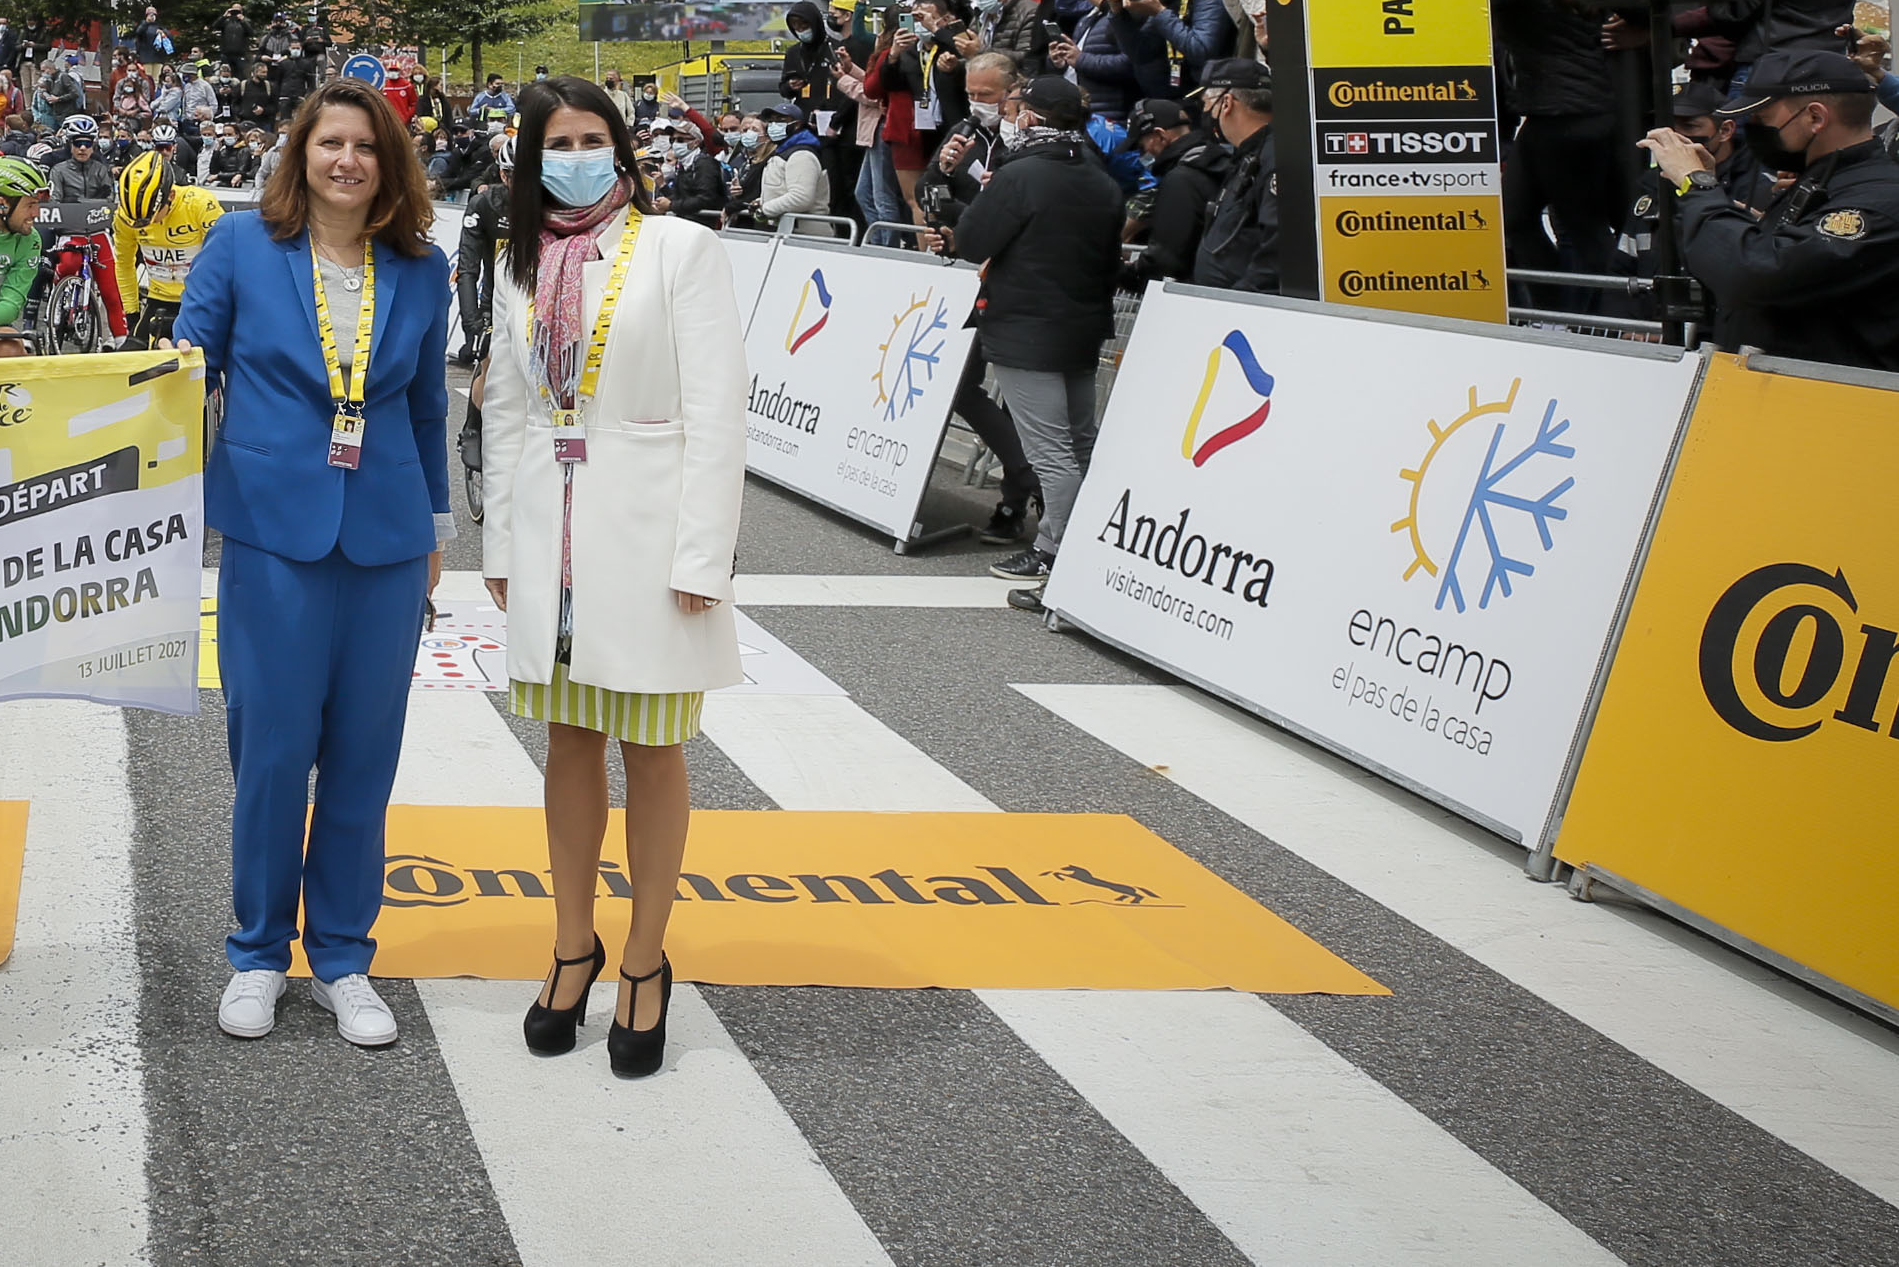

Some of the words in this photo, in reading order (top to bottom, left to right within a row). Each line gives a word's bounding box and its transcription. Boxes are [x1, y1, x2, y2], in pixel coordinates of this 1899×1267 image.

[1328, 80, 1457, 108] Continental
[1790, 82, 1832, 94] POLICIA
[1369, 132, 1488, 154] TISSOT
[168, 224, 198, 237] LCL
[202, 219, 217, 229] LC
[1335, 210, 1466, 237] Continental
[152, 249, 186, 262] UAE
[1338, 269, 1469, 297] Continental
[747, 372, 821, 436] Andorra
[847, 425, 909, 478] encamp
[843, 467, 860, 487] pas
[878, 477, 898, 498] casa
[2, 547, 44, 590] DE
[53, 534, 96, 573] LA
[104, 512, 188, 563] CASA
[1096, 489, 1277, 610] Andorra
[1103, 566, 1234, 642] visitandorra.com
[77, 660, 93, 680] 13
[96, 646, 155, 676] JUILLET
[157, 640, 188, 661] 2021
[1347, 607, 1513, 716] encamp
[1331, 661, 1353, 695] el
[1349, 672, 1386, 714] pas
[1388, 680, 1416, 719] de
[1421, 691, 1438, 733] la
[1441, 712, 1493, 757] casa
